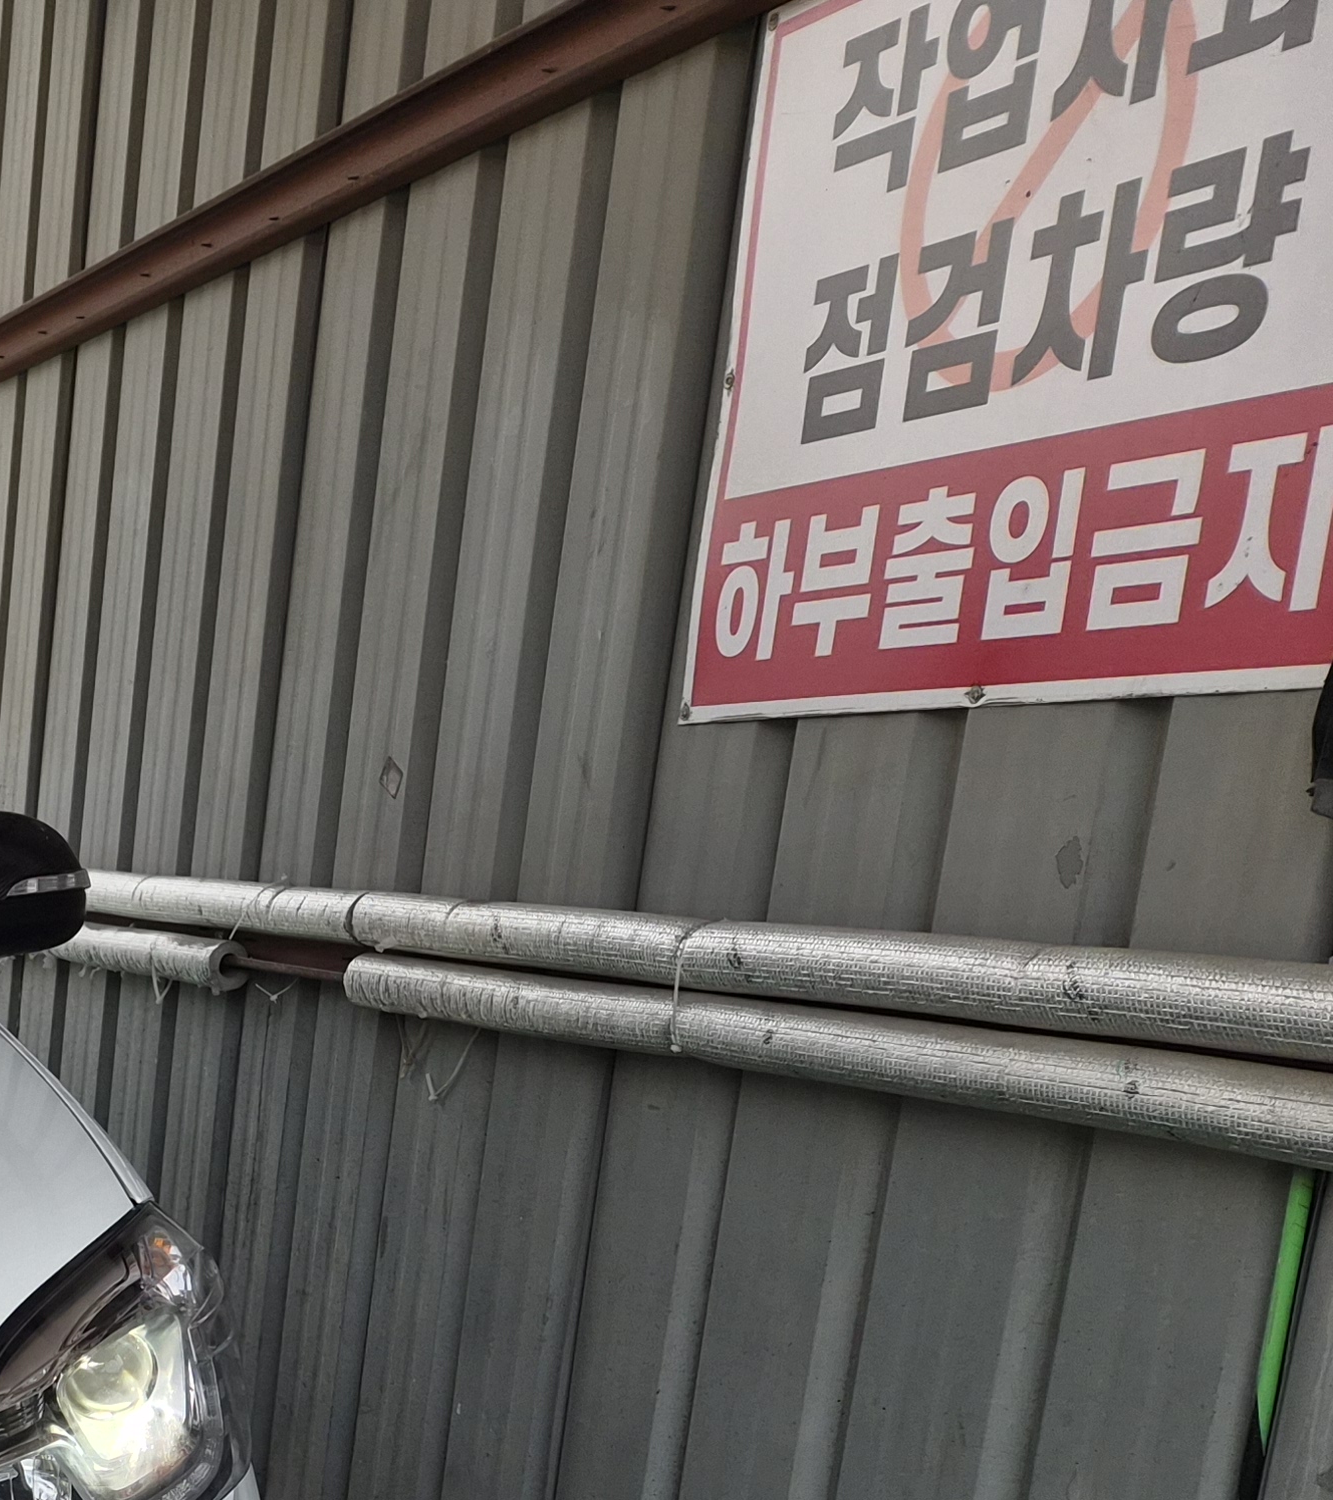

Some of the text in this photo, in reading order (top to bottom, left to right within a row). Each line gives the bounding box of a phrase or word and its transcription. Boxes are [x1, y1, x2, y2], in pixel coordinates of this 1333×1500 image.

[832, 0, 1319, 193] 작업
[800, 130, 1311, 445] 점검차량
[715, 424, 1333, 661] 하부출입금지
